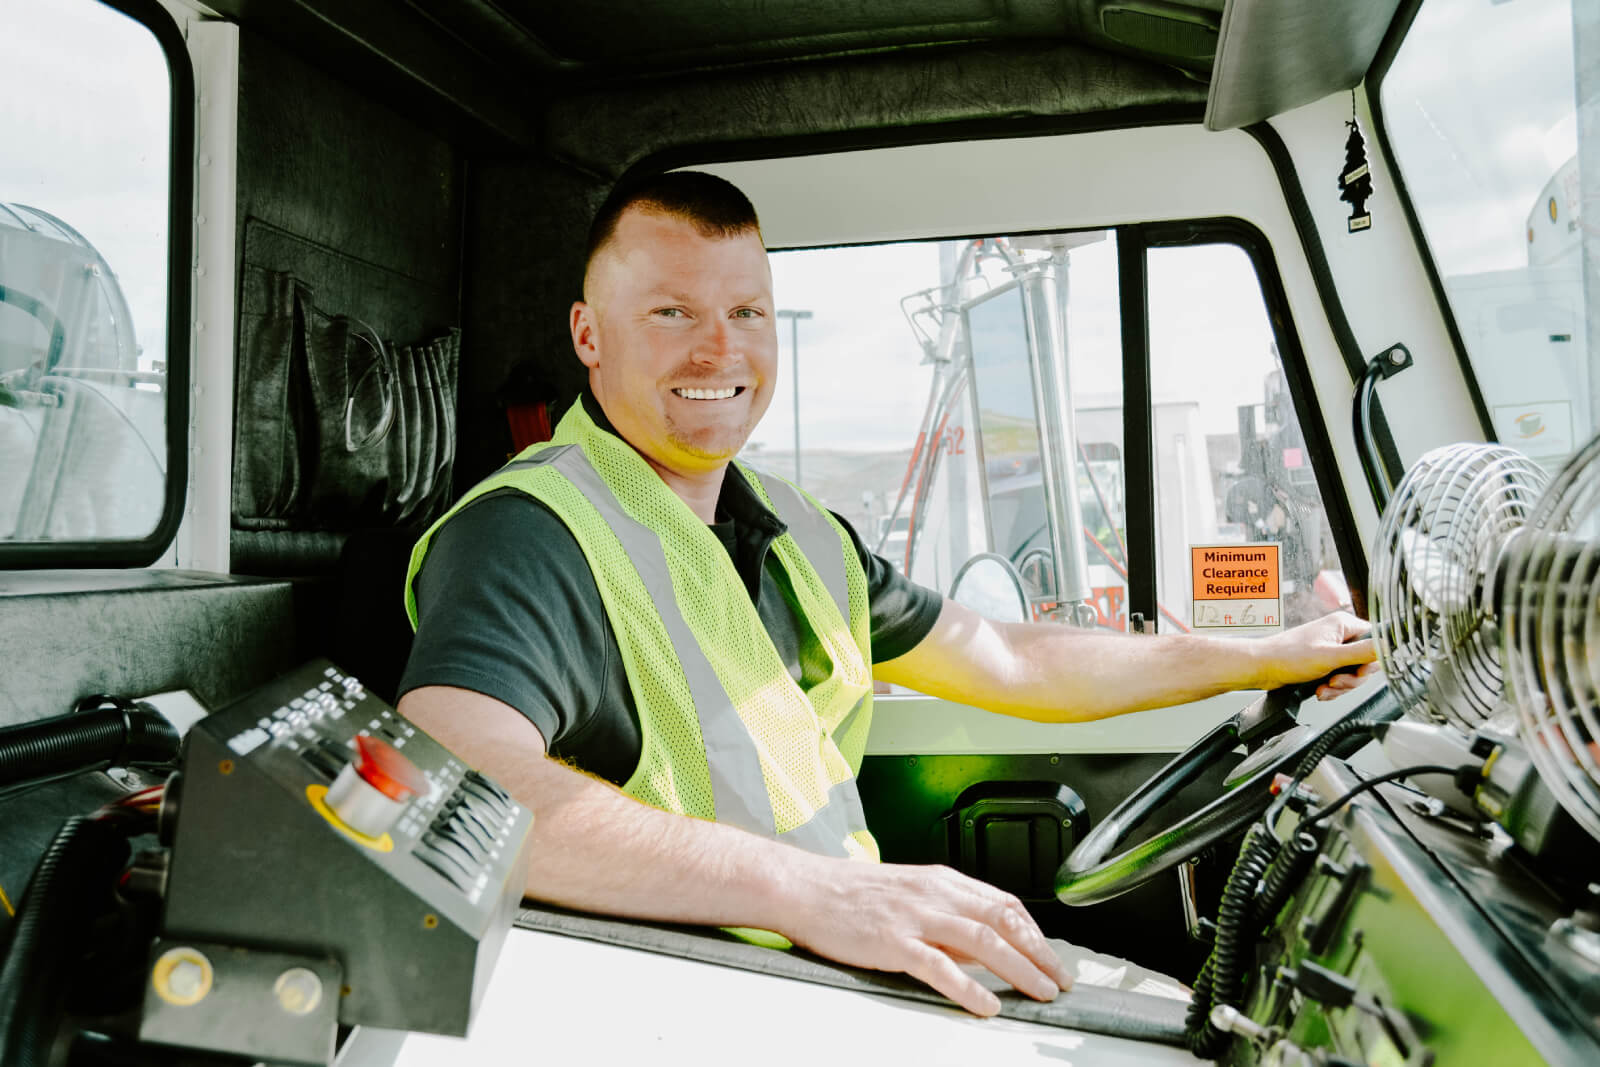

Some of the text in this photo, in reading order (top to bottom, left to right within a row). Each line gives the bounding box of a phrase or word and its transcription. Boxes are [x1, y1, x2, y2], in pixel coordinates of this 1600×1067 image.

[1204, 551, 1266, 562] Minimum
[1202, 568, 1269, 578] Clearance
[1206, 582, 1266, 596] Required
[1240, 604, 1256, 624] 6
